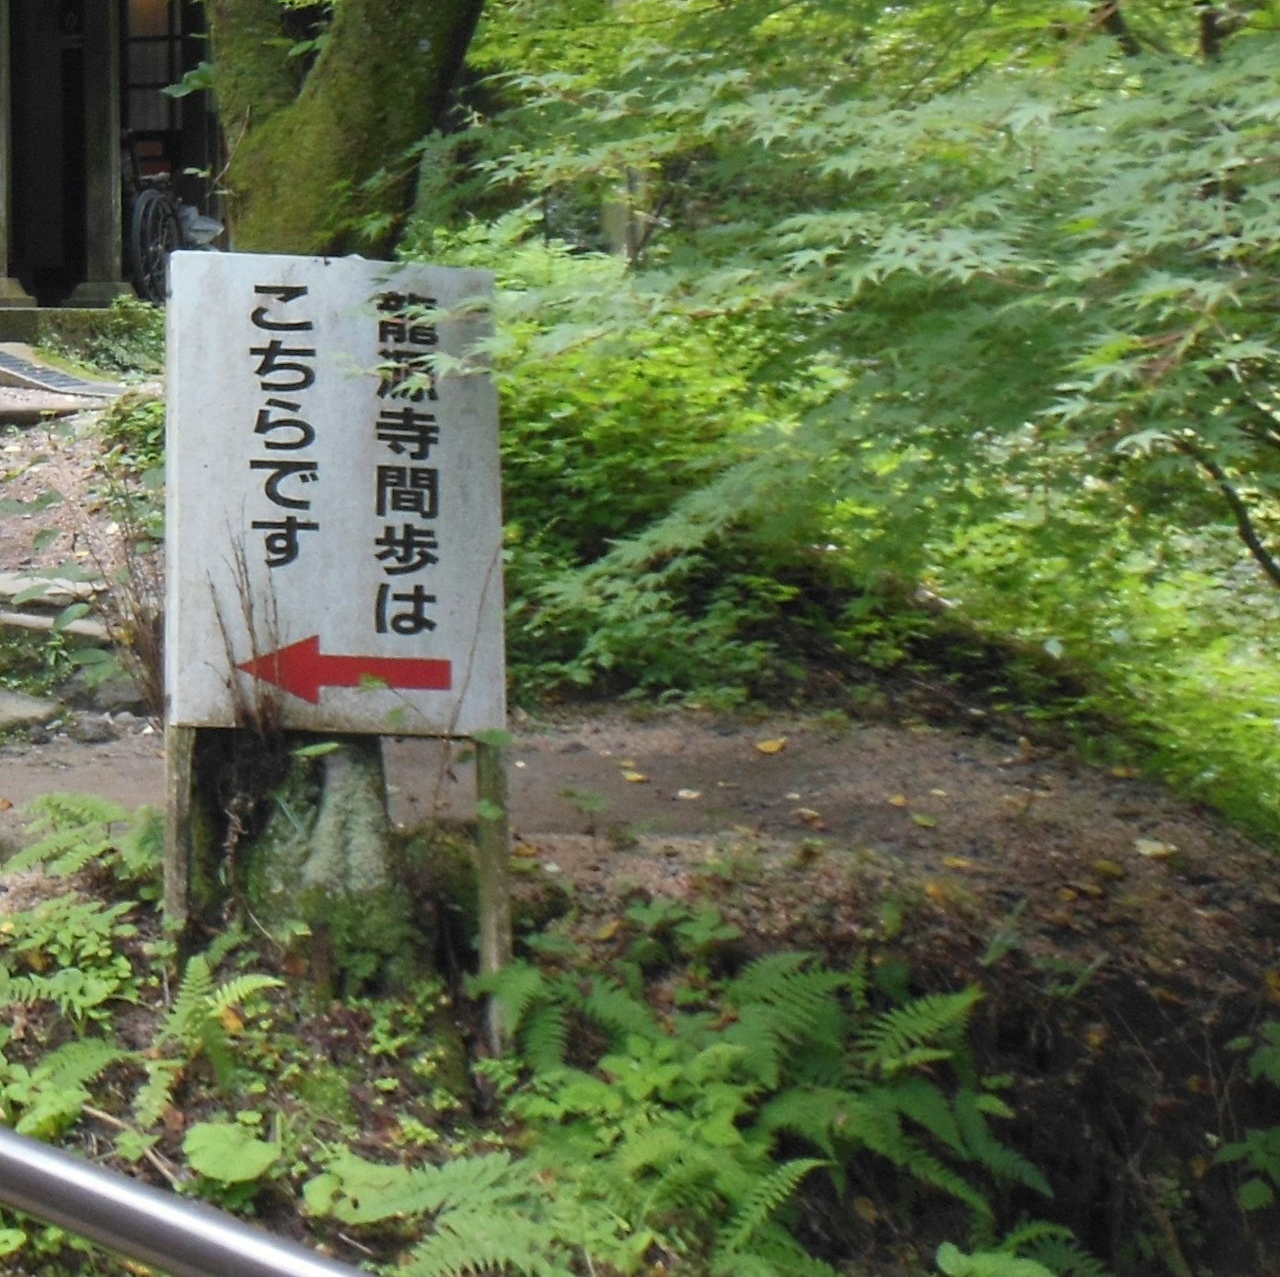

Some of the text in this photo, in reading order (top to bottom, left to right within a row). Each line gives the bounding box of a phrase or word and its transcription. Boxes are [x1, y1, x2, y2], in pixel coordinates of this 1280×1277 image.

[249, 284, 321, 569] こちらです
[373, 290, 441, 636] 龍源寺間歩は
